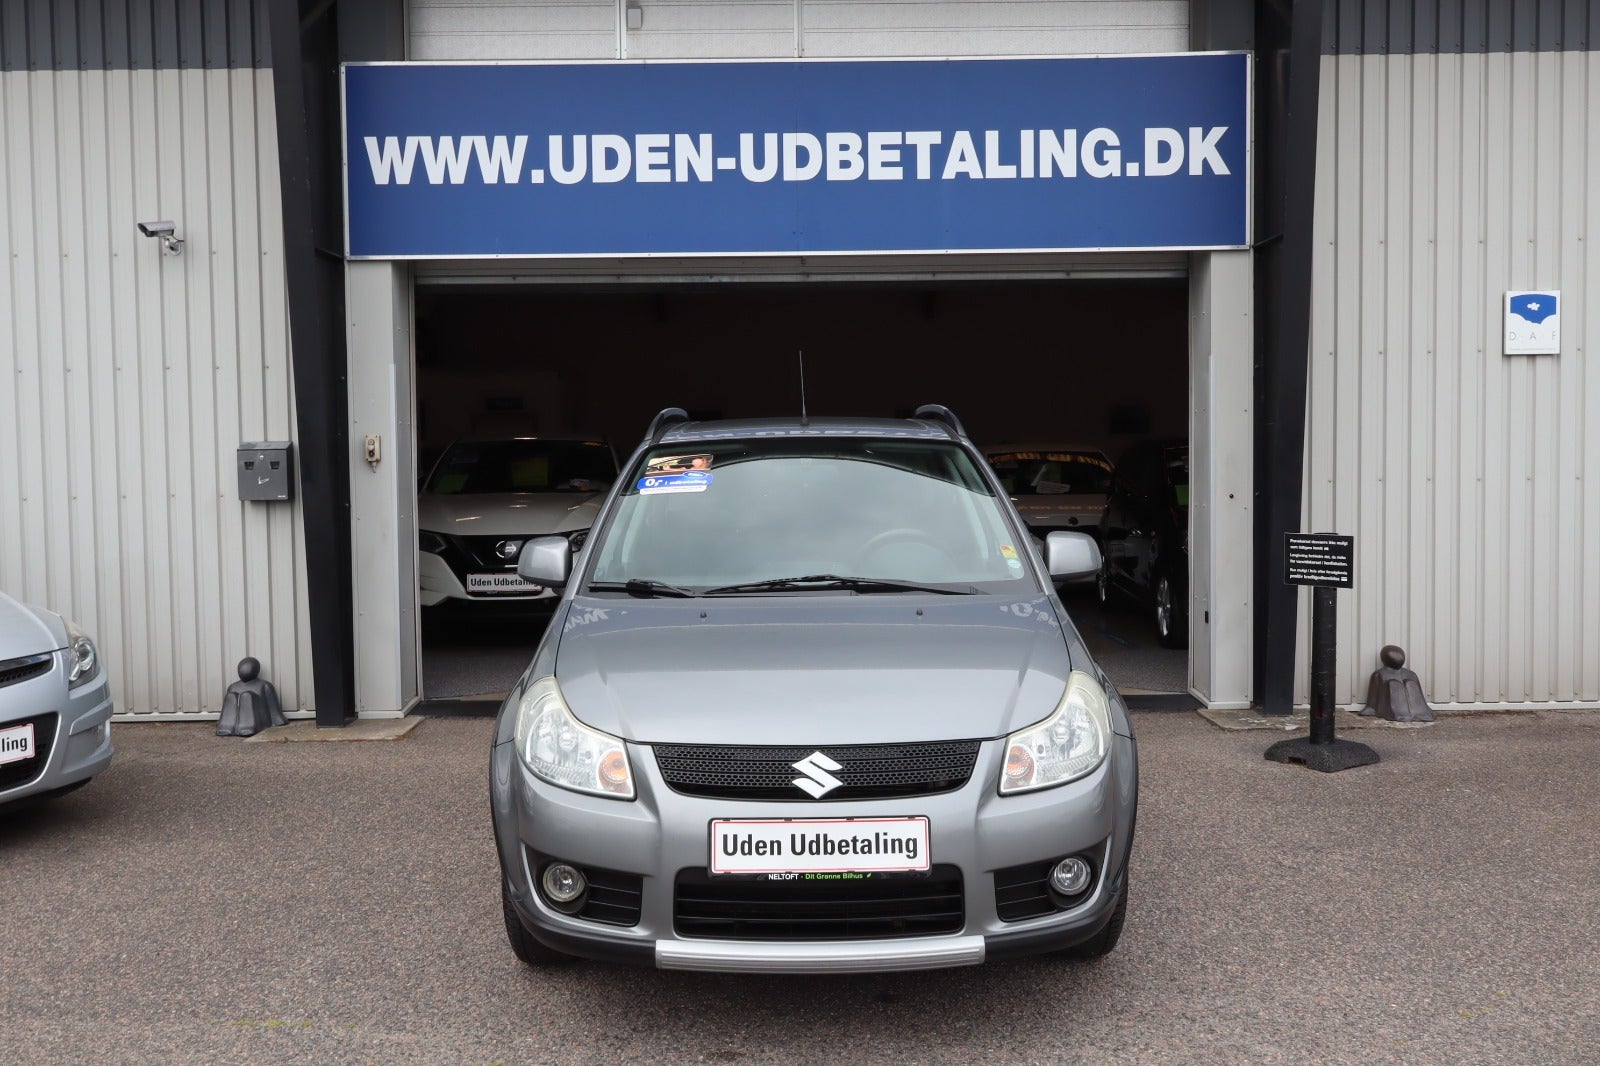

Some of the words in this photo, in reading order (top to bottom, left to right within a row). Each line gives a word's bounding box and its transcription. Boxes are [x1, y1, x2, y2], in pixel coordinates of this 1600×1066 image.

[363, 126, 1230, 185] WWW.UDEN-UDBETALING.DK
[470, 577, 492, 587] Uden
[722, 833, 782, 857] Uden
[790, 831, 919, 860] Udbetaling
[768, 873, 799, 881] NELTOFT
